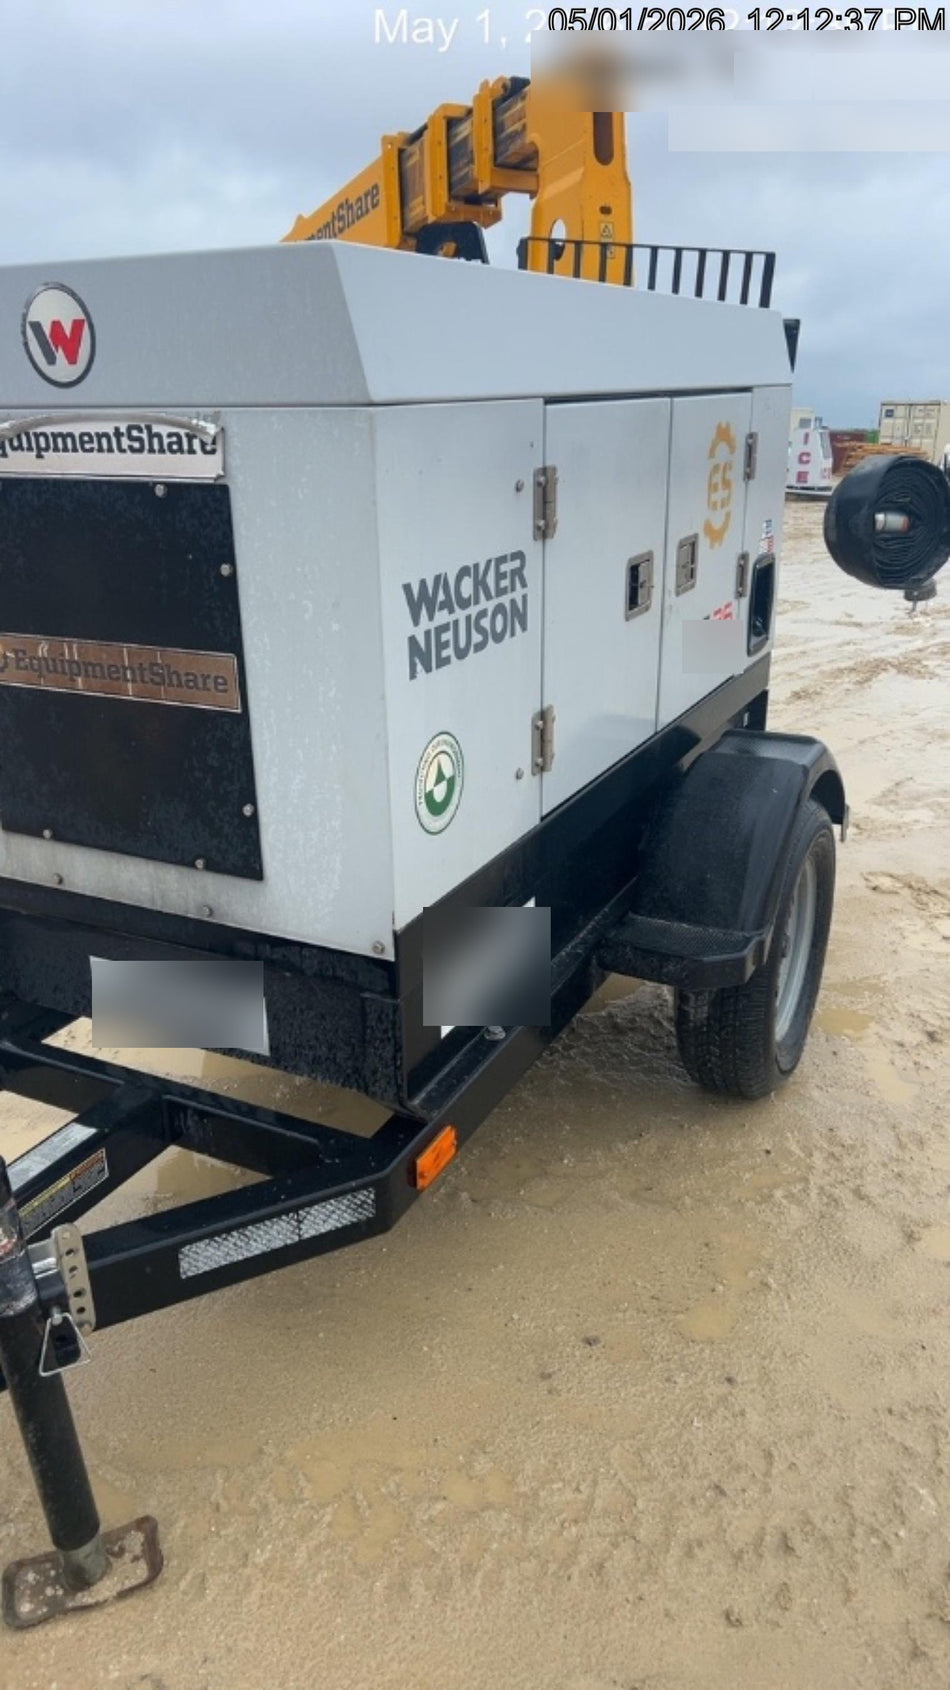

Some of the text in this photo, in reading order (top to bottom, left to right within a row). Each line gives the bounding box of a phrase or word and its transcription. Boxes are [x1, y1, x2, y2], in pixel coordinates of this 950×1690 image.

[28, 318, 86, 366] W
[402, 550, 528, 627] WACKER
[407, 593, 528, 681] NEUSON
[15, 648, 228, 694] EquipmentShare
